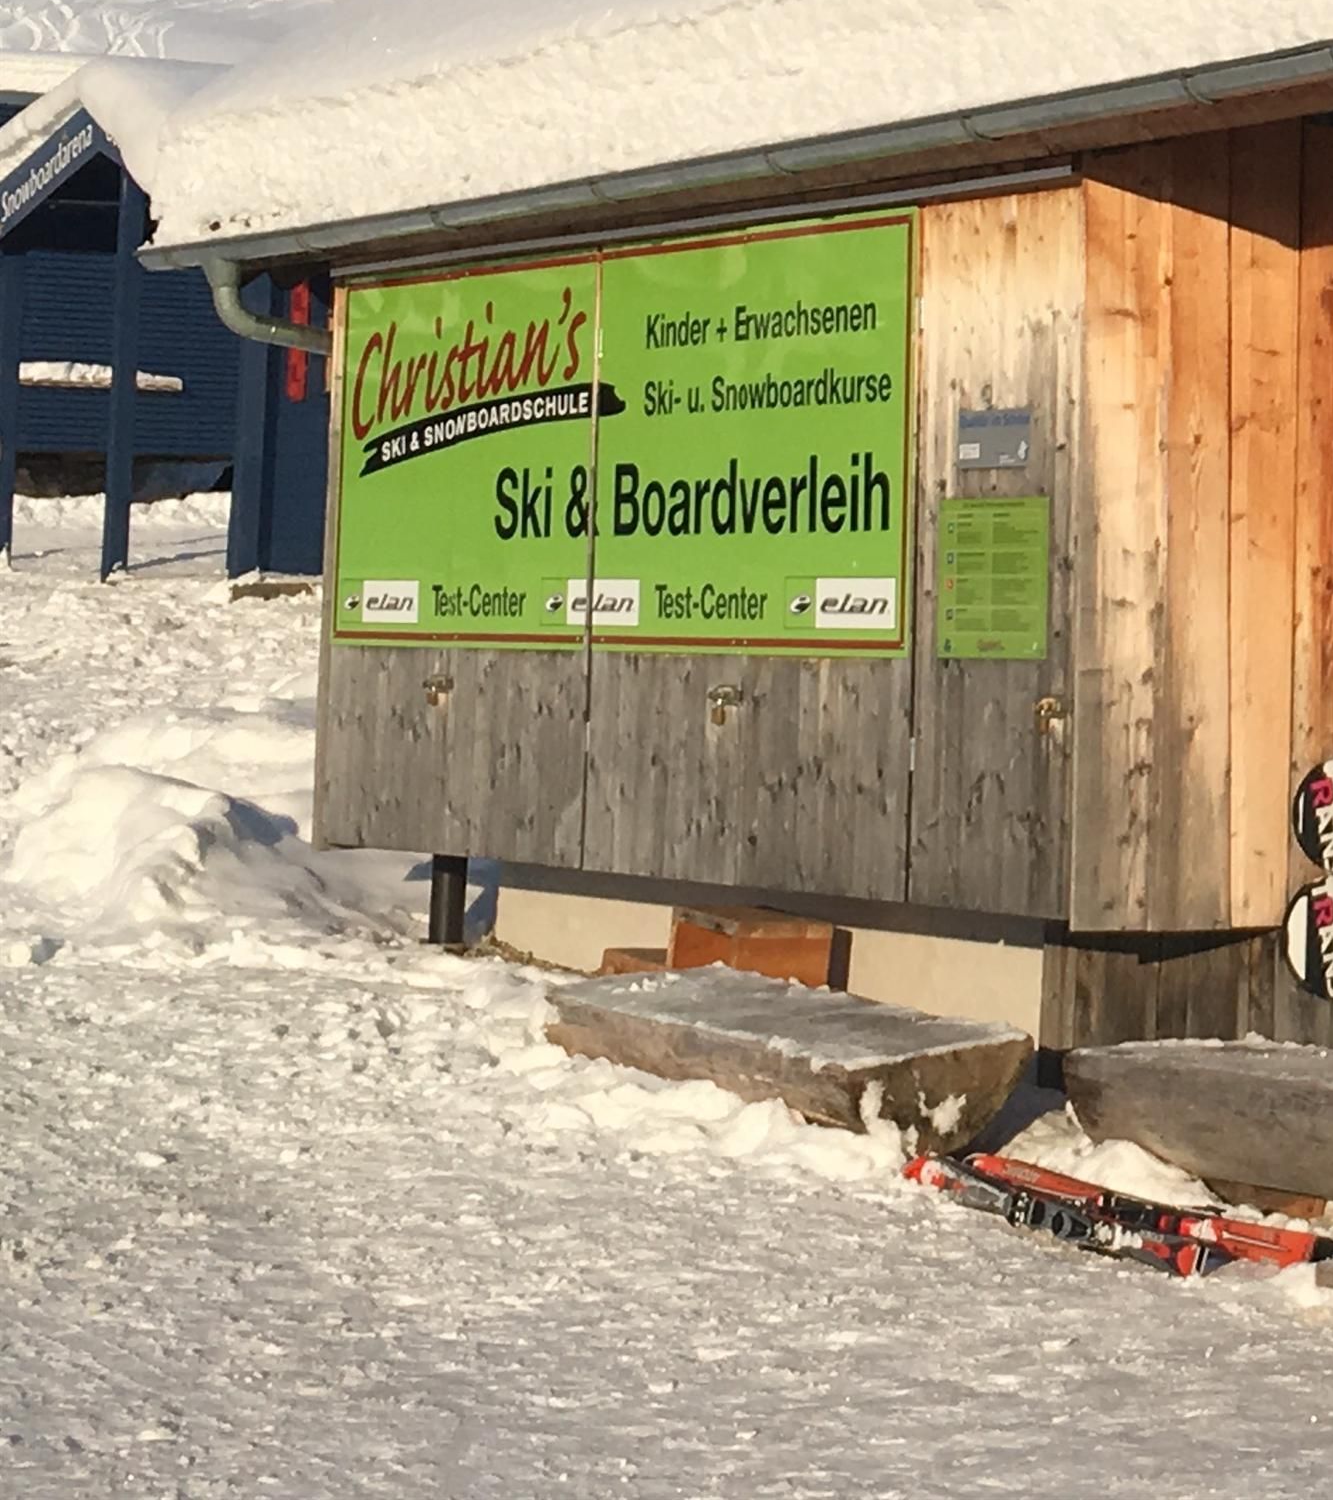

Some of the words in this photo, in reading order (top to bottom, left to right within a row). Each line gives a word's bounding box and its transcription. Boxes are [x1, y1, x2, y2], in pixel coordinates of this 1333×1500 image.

[2, 124, 92, 222] Snowboardarena
[646, 313, 711, 350] Kinder
[715, 320, 728, 339] +
[735, 301, 877, 343] Erwachsenen
[353, 286, 587, 441] Christian's
[644, 380, 683, 417] Ski-
[687, 385, 705, 413] u.
[711, 369, 892, 411] Snowboardkurse
[381, 437, 407, 462] SKI
[410, 432, 420, 450] &
[424, 392, 589, 447] SNOWBOARDSCHULE
[494, 467, 553, 541] Ski
[565, 465, 600, 538] &
[614, 452, 890, 537] Boardverleih
[364, 593, 414, 613] elan
[432, 583, 526, 619] Test-Center
[571, 594, 635, 613] elan
[655, 583, 768, 621] Test-Center
[819, 595, 889, 616] elan
